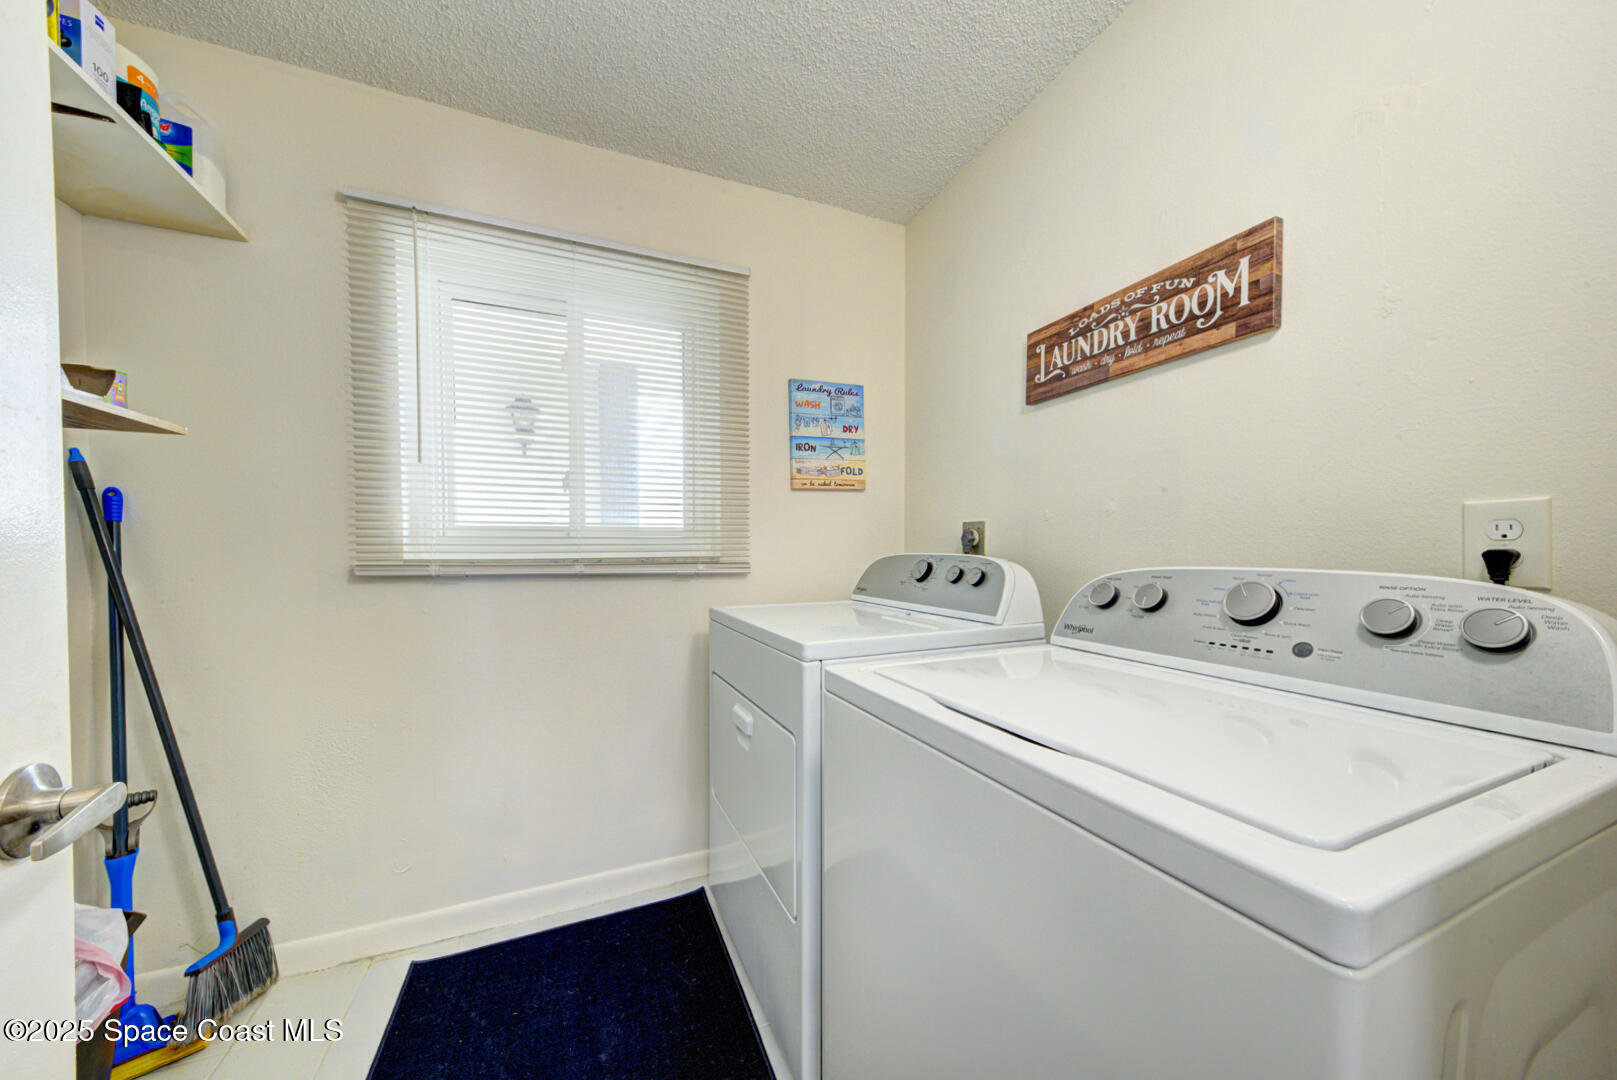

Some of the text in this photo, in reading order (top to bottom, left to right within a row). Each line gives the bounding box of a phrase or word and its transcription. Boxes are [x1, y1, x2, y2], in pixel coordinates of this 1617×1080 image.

[60, 16, 72, 27] ES
[92, 62, 109, 83] 100
[1068, 278, 1196, 336] LOADS OF FUN
[1035, 255, 1251, 383] LAUNDRY ROOM
[1100, 353, 1116, 366] dry
[1123, 342, 1143, 359] fold
[1152, 327, 1187, 347] repeat
[796, 383, 860, 397] Laundry Rules
[795, 400, 821, 409] WASH
[842, 425, 859, 433] DRY
[795, 442, 817, 452] IRON
[840, 466, 863, 476] FOLD
[1064, 623, 1094, 634] Whirlpool
